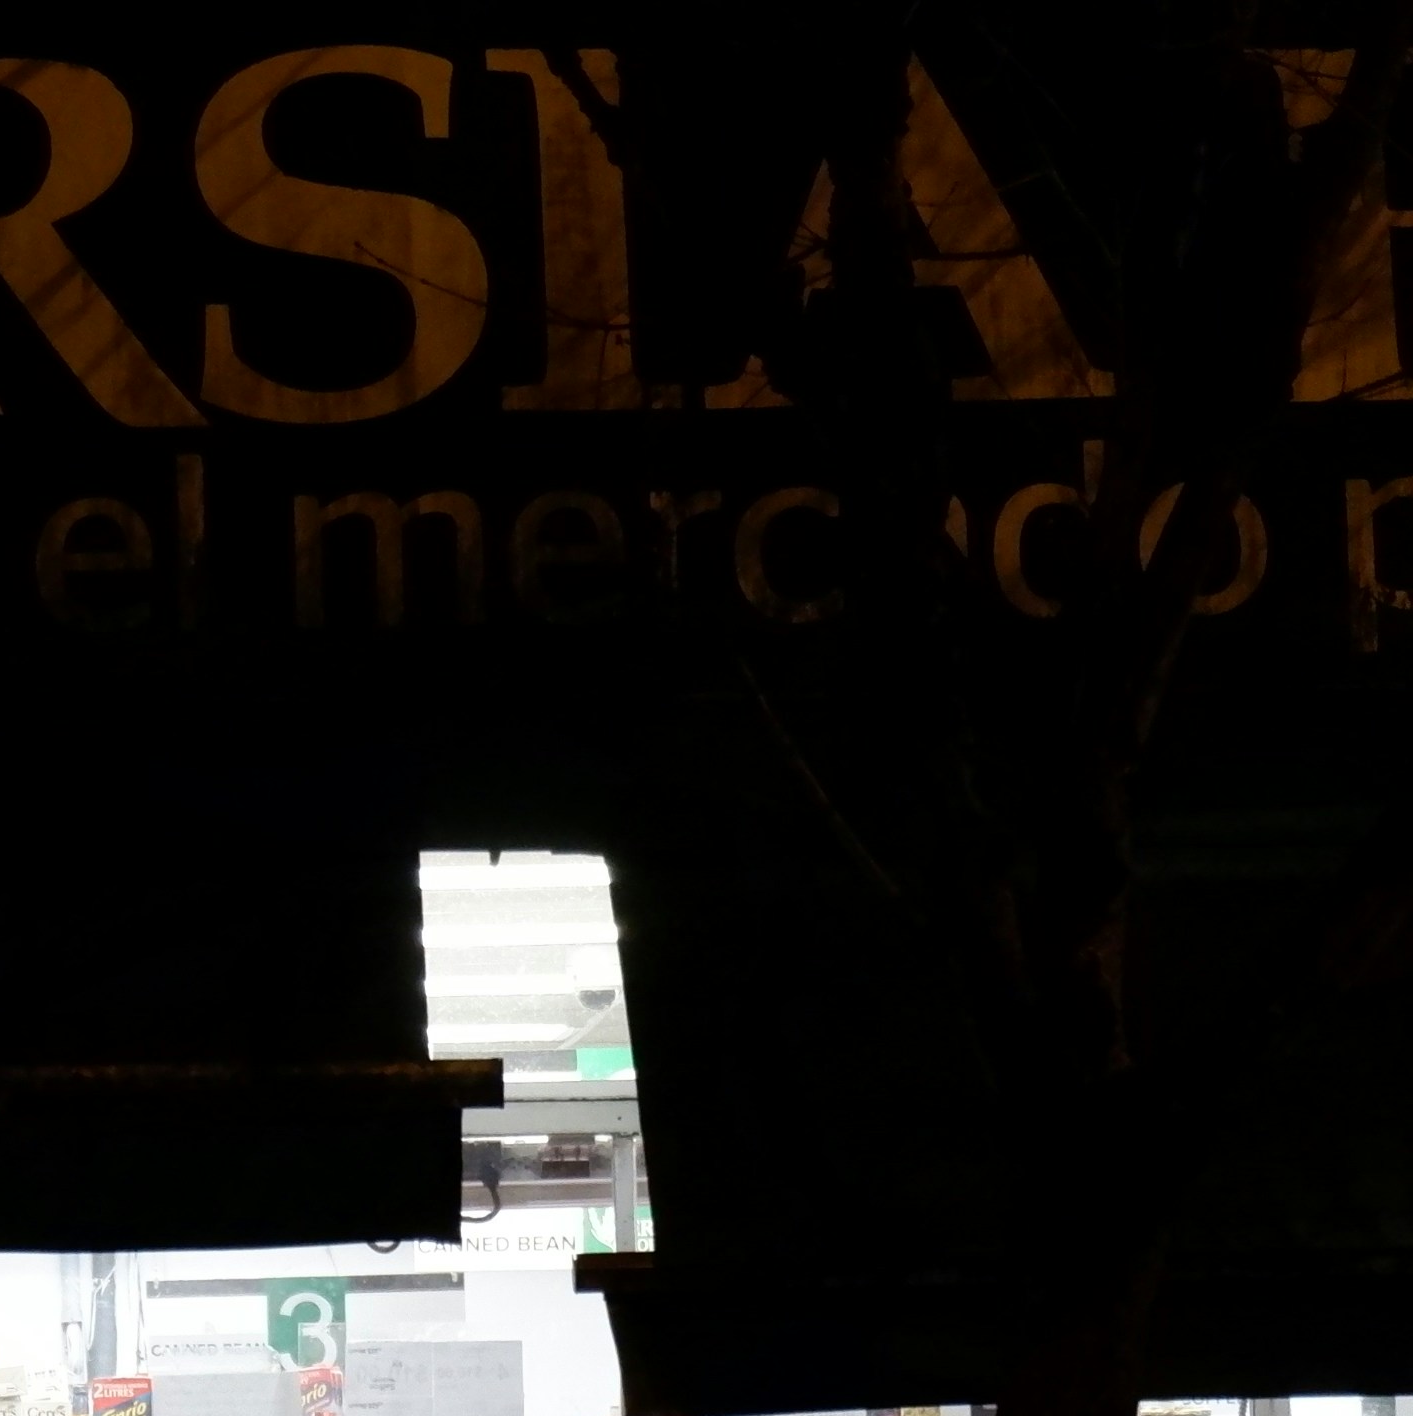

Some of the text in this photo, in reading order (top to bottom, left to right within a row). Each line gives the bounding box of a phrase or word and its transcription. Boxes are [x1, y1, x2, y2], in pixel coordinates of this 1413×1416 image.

[33, 451, 206, 627] el
[291, 438, 1270, 628] mercdo
[519, 1235, 576, 1253] BEAN
[279, 1292, 337, 1371] 3
[94, 1383, 104, 1398] 2
